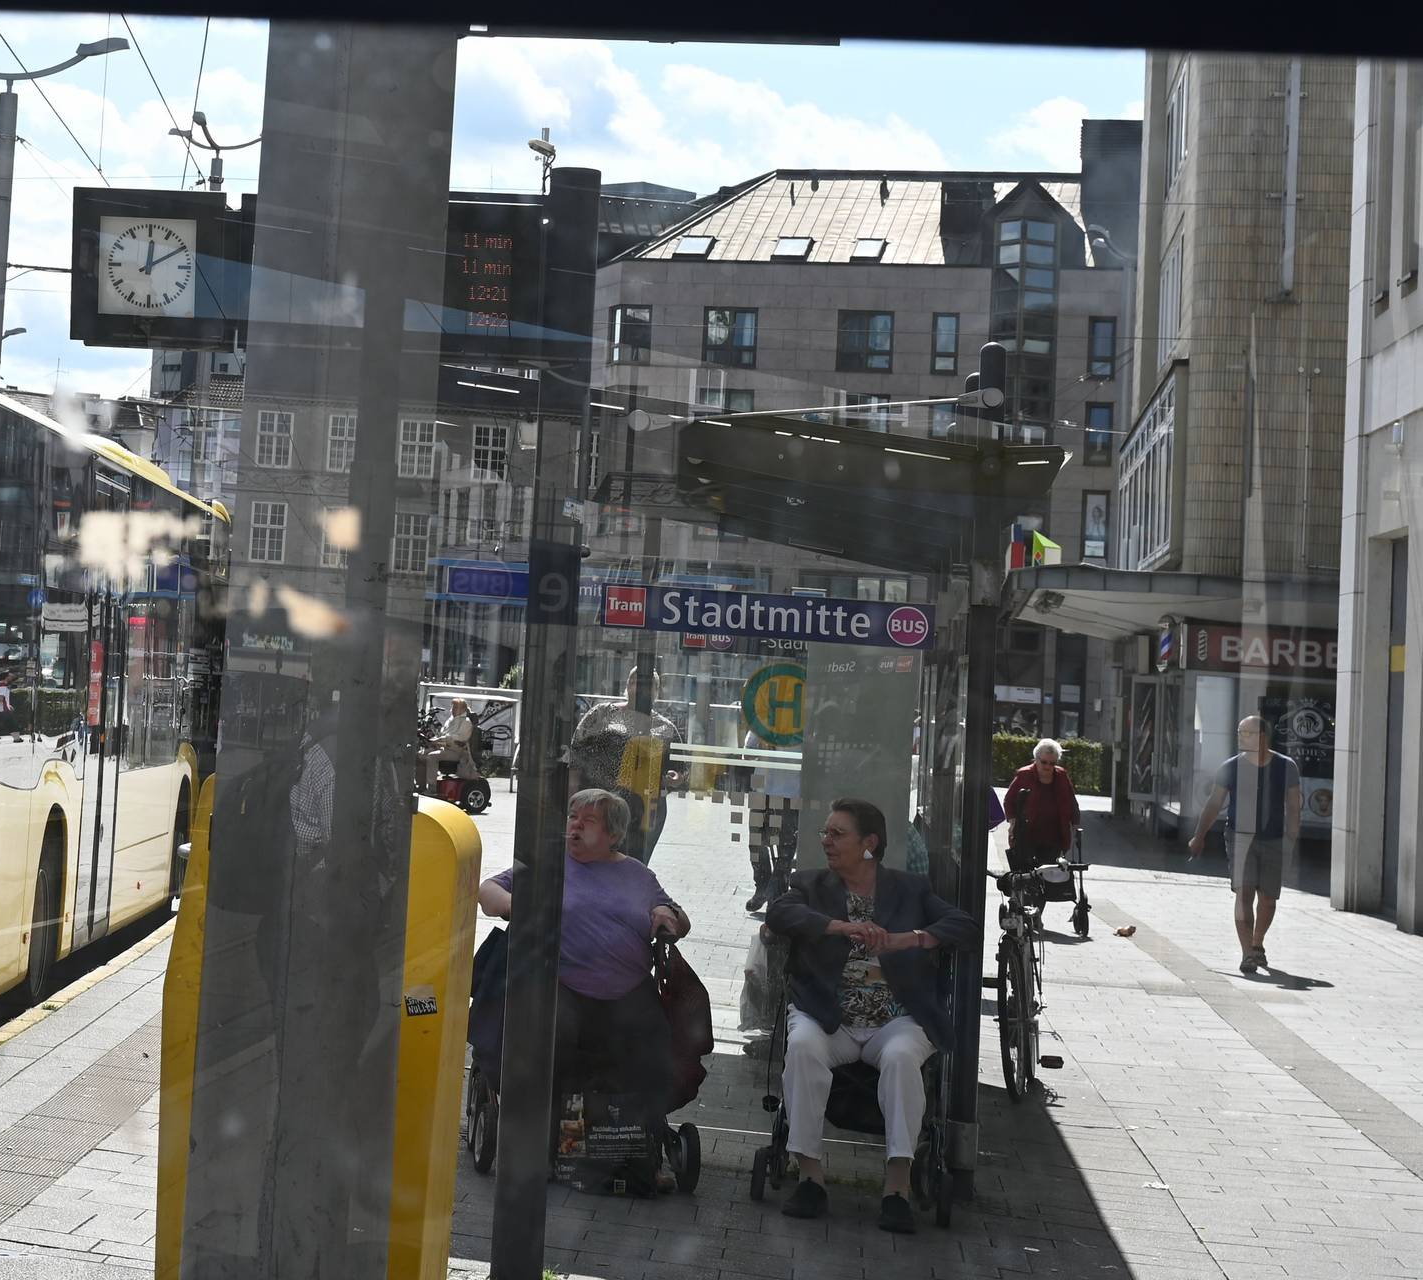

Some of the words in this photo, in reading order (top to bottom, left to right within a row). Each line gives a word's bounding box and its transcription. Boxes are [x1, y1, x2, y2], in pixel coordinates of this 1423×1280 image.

[464, 232, 479, 248] 11
[485, 234, 513, 249] min
[463, 257, 478, 274] 11
[483, 260, 512, 275] min
[468, 285, 508, 302] 12:21
[608, 596, 643, 613] Tram
[661, 590, 872, 639] Stadtmitte
[890, 617, 926, 635] BUS
[711, 633, 732, 643] BUS
